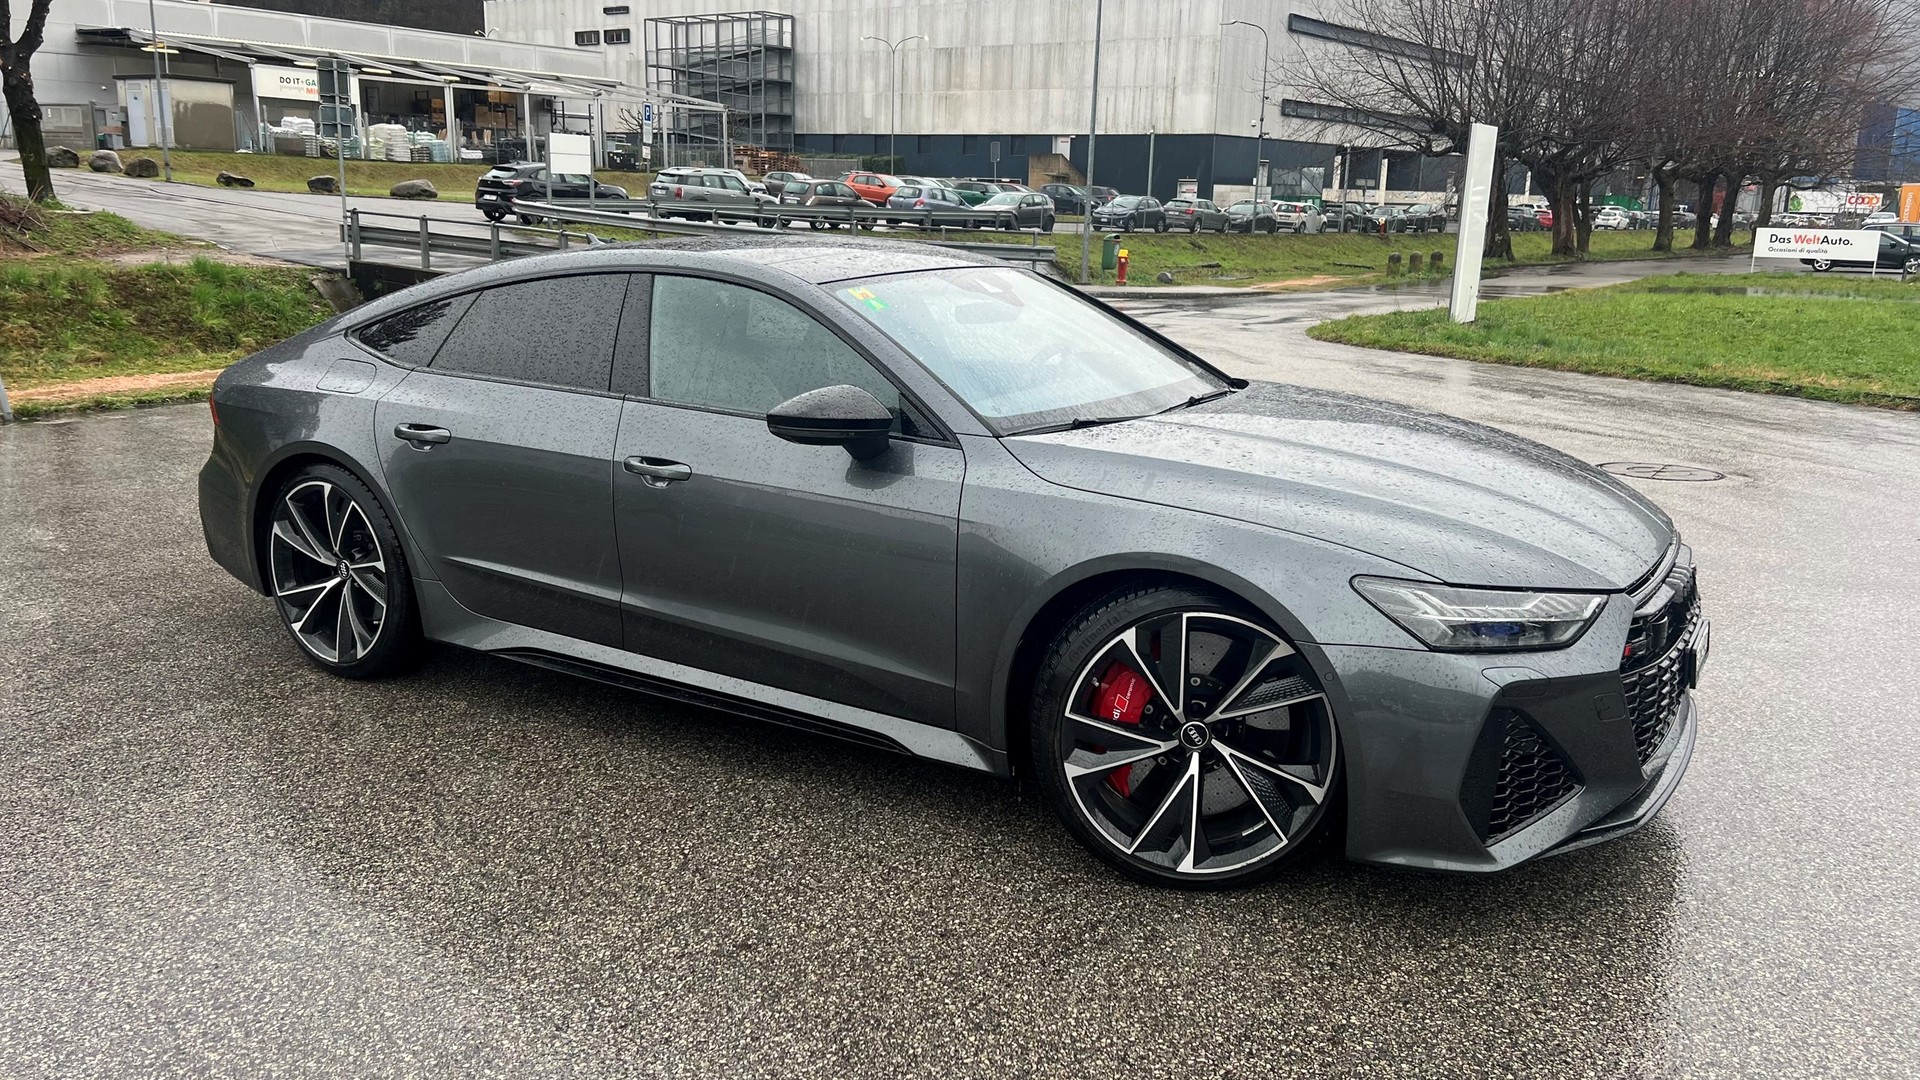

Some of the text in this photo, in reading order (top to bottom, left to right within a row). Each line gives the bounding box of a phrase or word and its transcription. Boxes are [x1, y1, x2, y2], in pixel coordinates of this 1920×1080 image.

[305, 79, 317, 87] GA
[646, 107, 650, 120] P
[1848, 194, 1880, 208] coop
[1769, 234, 1853, 246] Das WeltAuto.
[1125, 677, 1136, 700] ceramic
